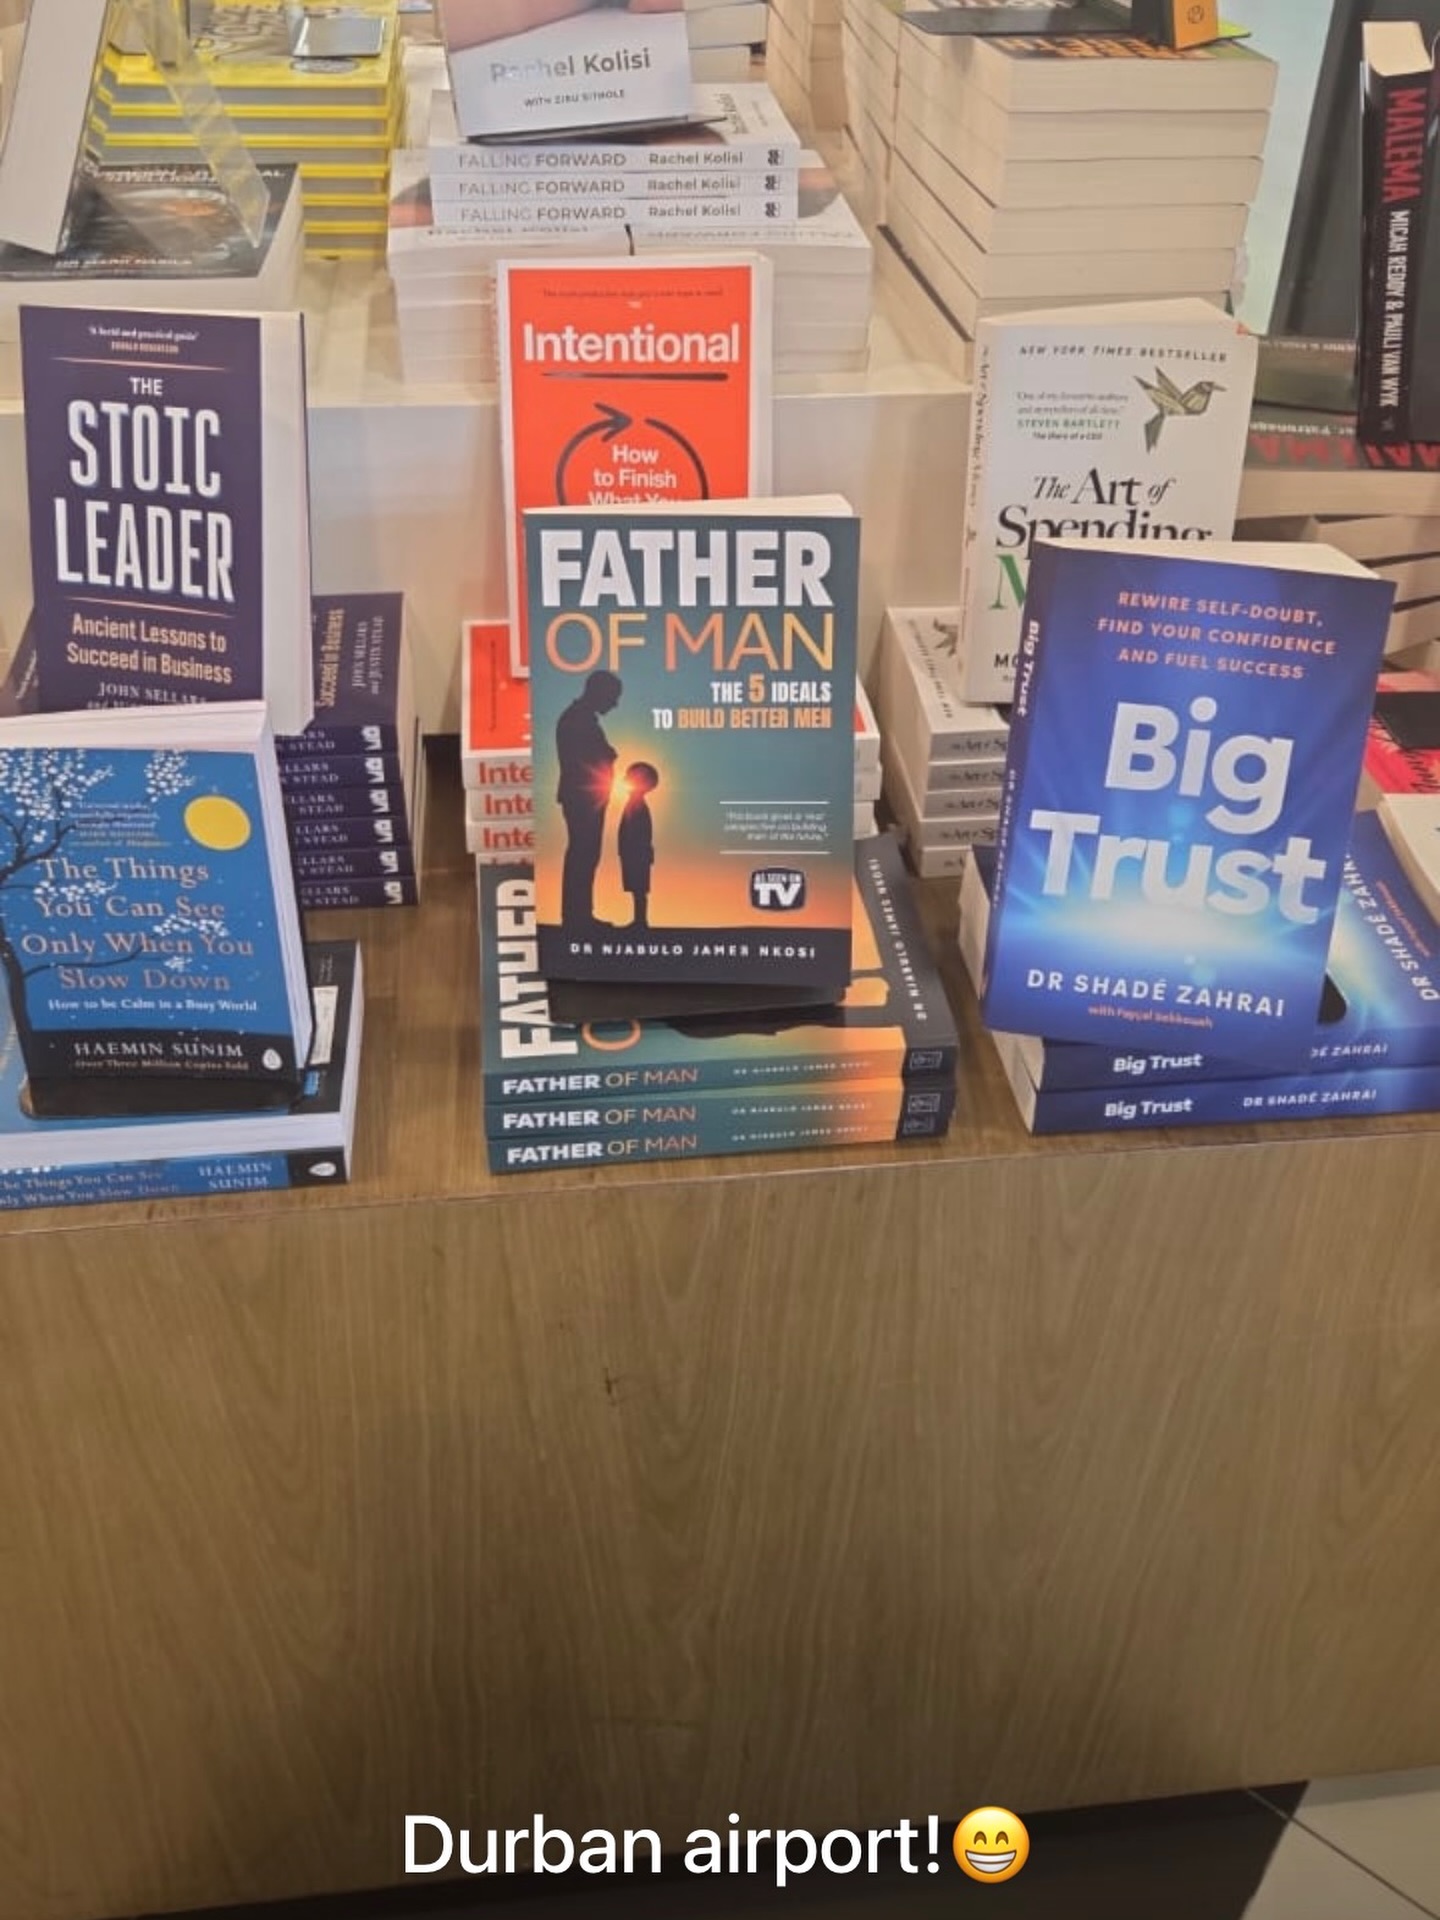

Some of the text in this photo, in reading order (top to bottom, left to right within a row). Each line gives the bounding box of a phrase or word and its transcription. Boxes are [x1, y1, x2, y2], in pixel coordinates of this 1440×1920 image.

[584, 48, 652, 74] Kolisi
[524, 97, 552, 107] WITH
[1383, 88, 1427, 203] MALEMA
[459, 151, 743, 168] FALLING FORWARD Rachel Kolisi
[459, 177, 741, 196] FALLING FORWARD Rachel Kolisi
[461, 203, 741, 222] FALLING FORWARD Rachel Kolisi
[1389, 210, 1410, 253] MICAH
[1386, 256, 1407, 297] REDDY
[1386, 300, 1404, 311] &
[523, 323, 740, 364] Intentional
[1020, 346, 1227, 363] NEW YORK TIMES BESTSELLER
[1381, 350, 1401, 374] VAN
[129, 376, 163, 397] THE
[1380, 377, 1399, 407] WYK
[1017, 420, 1120, 429] STEVEN BARTLETT
[68, 400, 221, 498] STOIC
[612, 444, 659, 464] How
[594, 469, 677, 489] to Finish
[1034, 467, 1176, 506] The Art of
[54, 497, 235, 602] LEADER
[540, 529, 833, 607] FATHER
[1119, 591, 1323, 627] REWIRE SELF-DOUBT,
[72, 612, 227, 653] Ancient Lessons to
[545, 613, 833, 671] OF MAN
[1097, 618, 1336, 655] FIND YOUR CONFIDENCE
[67, 641, 232, 684] Succeed in Business
[1017, 620, 1040, 717] Big Trust
[1118, 648, 1304, 679] AND FUEL SUCCESS
[97, 682, 140, 697] JOHN
[711, 673, 831, 703] THE 5 IDEALS
[653, 707, 831, 729] TO BUILD BETTER MEN
[289, 741, 336, 751] STEAD
[1105, 696, 1293, 835] Big
[292, 773, 339, 784] STEAD
[37, 857, 209, 888] The Things
[1030, 809, 1327, 925] Trust
[36, 896, 225, 918] You Can See
[754, 883, 802, 906] TV
[21, 931, 254, 962] Only When You
[570, 943, 592, 954] DR
[602, 944, 683, 955] NJABULO
[759, 945, 815, 958] NKOSI
[1364, 913, 1419, 971] SHADÉ
[60, 965, 230, 991] Slow Down
[1412, 976, 1440, 1001] DR
[48, 999, 79, 1010] How
[84, 1000, 98, 1009] to
[101, 998, 117, 1009] be
[121, 999, 155, 1009] Calm
[159, 999, 172, 1009] in
[186, 999, 216, 1013] Busy
[218, 1000, 257, 1011] World
[1027, 969, 1284, 1017] DR SHADÉ ZAHRAI
[1088, 1004, 1115, 1018] with
[74, 1042, 243, 1057] HAEMIN SUNIM
[1331, 1044, 1388, 1057] ZAHRAI
[1113, 1053, 1203, 1075] Big Trust
[502, 1068, 698, 1095] FATHER OF MAN
[1104, 1099, 1193, 1120] Big Trust
[1243, 1089, 1377, 1107] DR SHADÉ ZAHRAI
[503, 1106, 697, 1129] FATHER OF MAN
[507, 1134, 697, 1164] FATHER OF MAN
[25, 1177, 73, 1192] Things
[74, 1175, 101, 1185] You
[106, 1173, 133, 1183] Can
[199, 1163, 272, 1190] HAEMIN SUNIM
[66, 1191, 94, 1201] You
